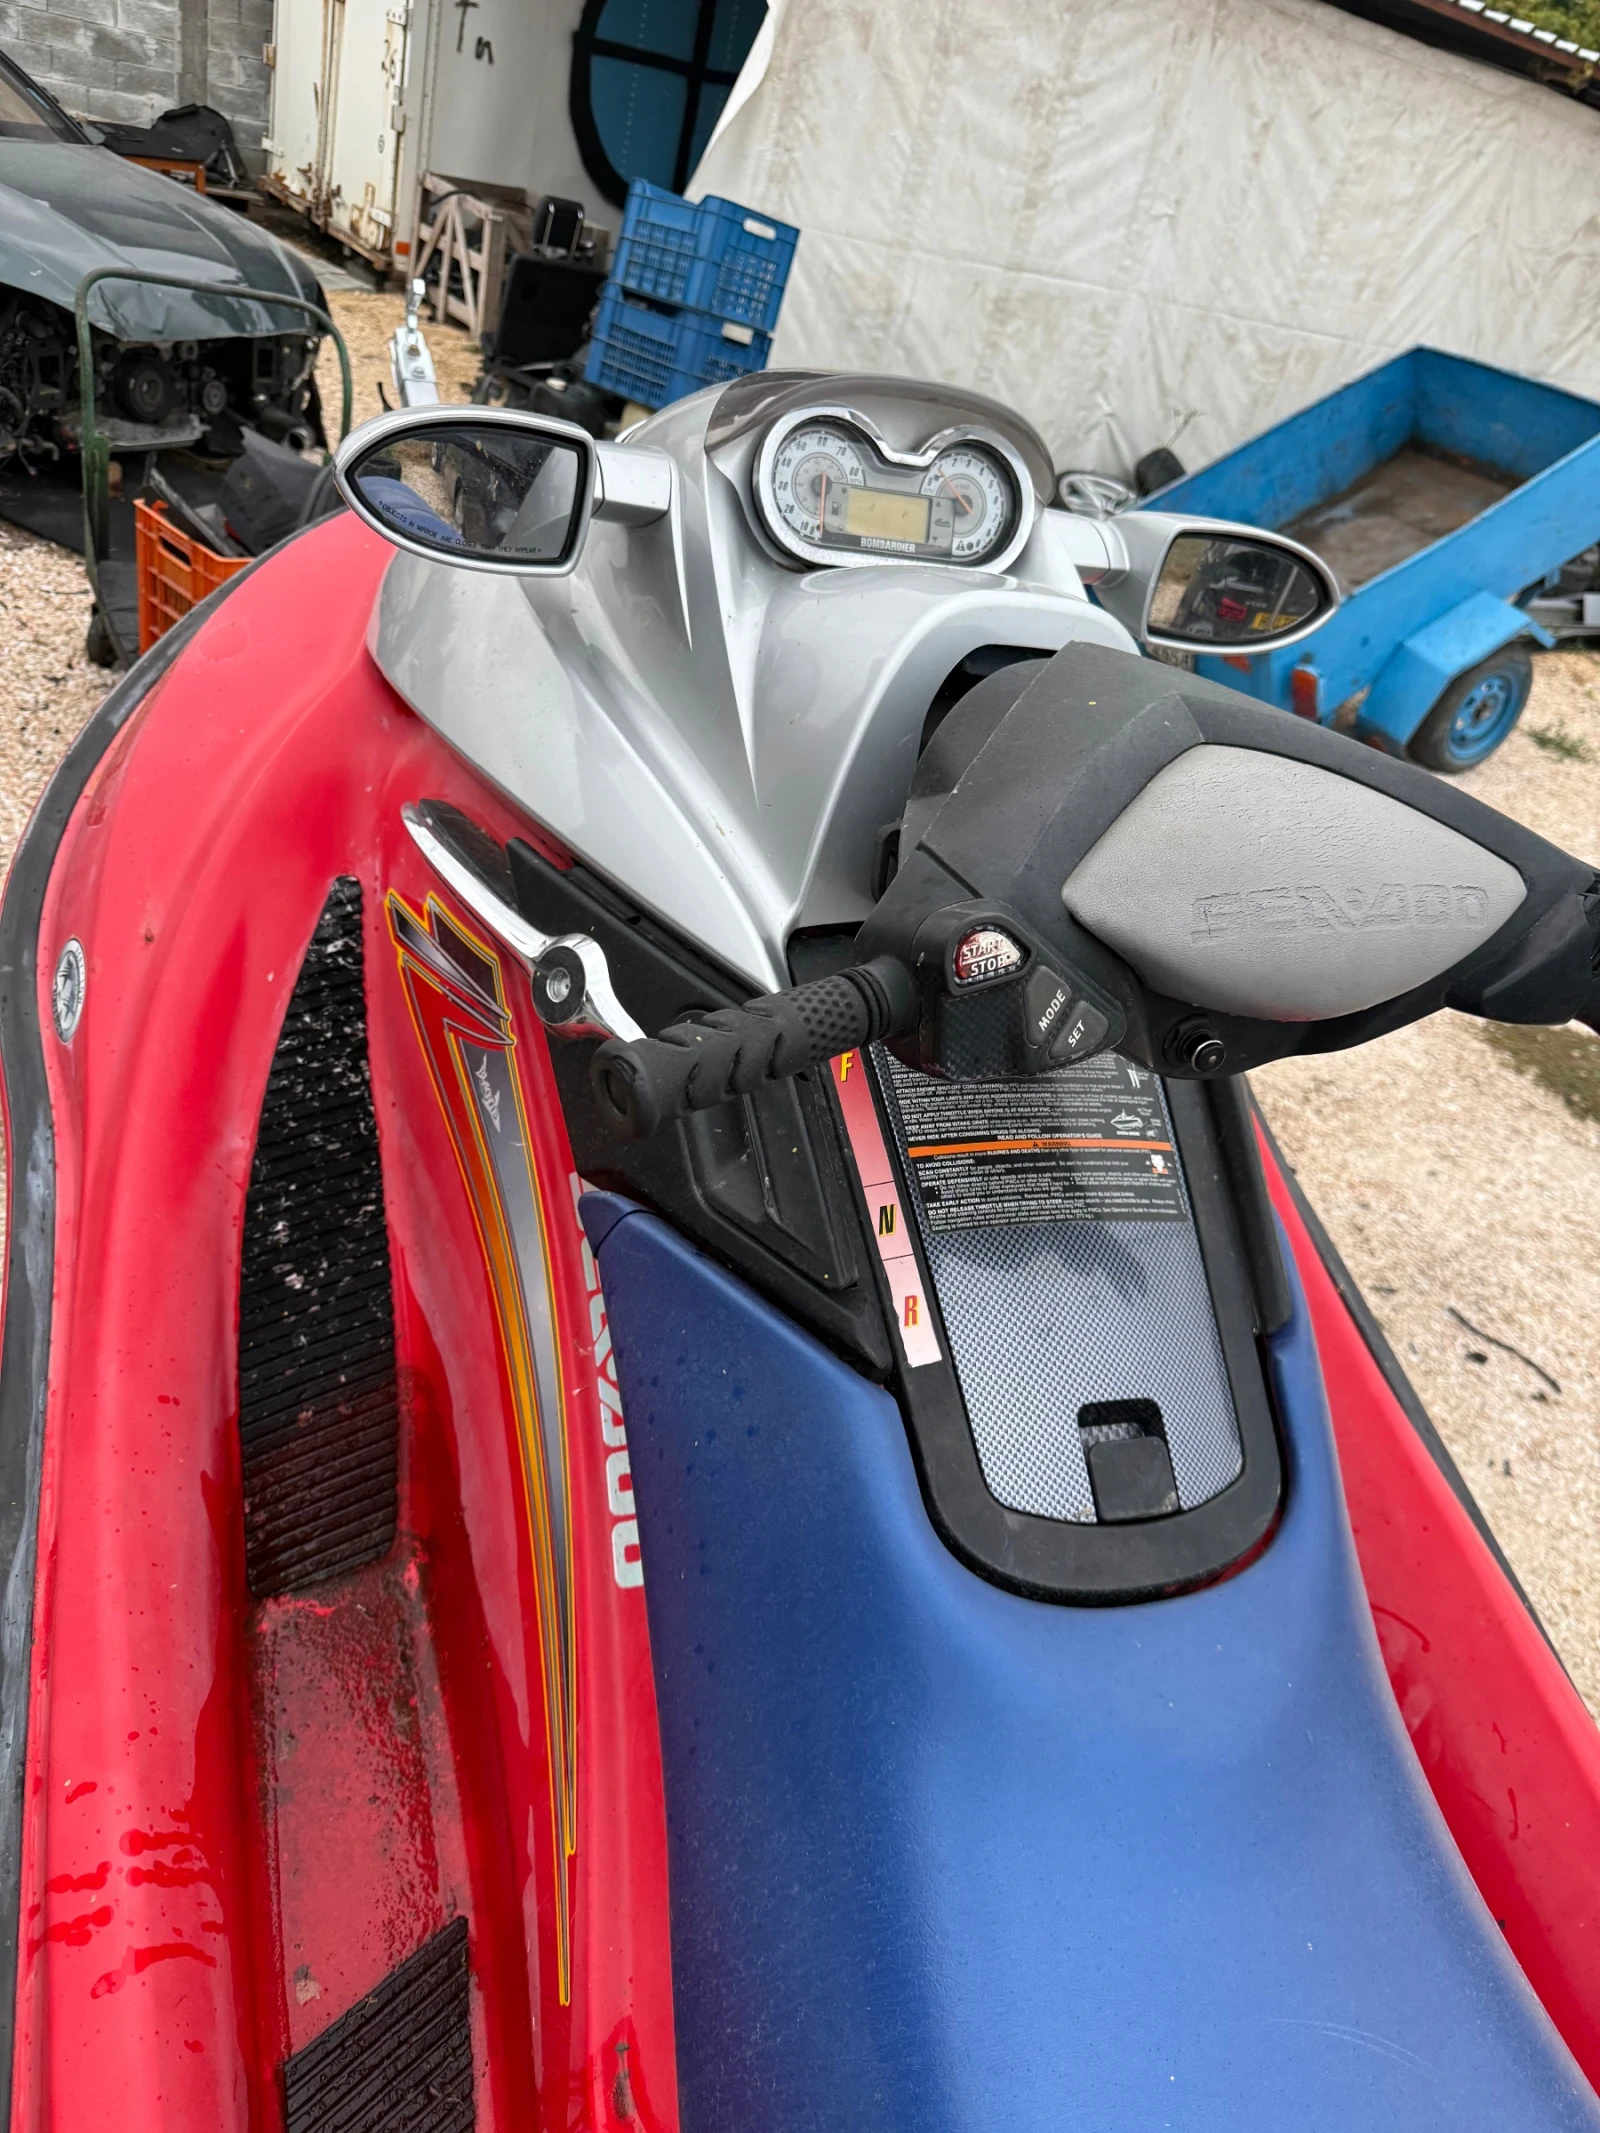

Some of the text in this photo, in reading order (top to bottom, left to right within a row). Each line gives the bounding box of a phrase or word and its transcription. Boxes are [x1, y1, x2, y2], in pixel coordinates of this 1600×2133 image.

[816, 436, 829, 447] 60
[836, 446, 847, 457] 70
[781, 457, 792, 468] 40
[952, 457, 958, 467] 2
[848, 466, 860, 477] 80
[777, 481, 789, 492] 30
[783, 503, 795, 515] 20
[382, 504, 408, 523] OBJECTS
[408, 520, 415, 528] IN
[417, 524, 437, 538] MIRROR
[441, 535, 453, 543] ARE
[800, 521, 809, 531] 10
[860, 537, 916, 554] BOMBARDIER
[963, 938, 1003, 960] START
[970, 955, 1005, 976] STOP
[1038, 989, 1066, 1032] MODE
[1067, 1019, 1086, 1048] SET
[840, 1052, 853, 1082] F
[935, 1166, 969, 1174] CONSTANTLY
[921, 1176, 982, 1188] OPERATE DEFENSIVELY
[950, 1204, 974, 1212] RELEASE
[879, 1203, 897, 1237] N
[904, 1294, 919, 1328] R
